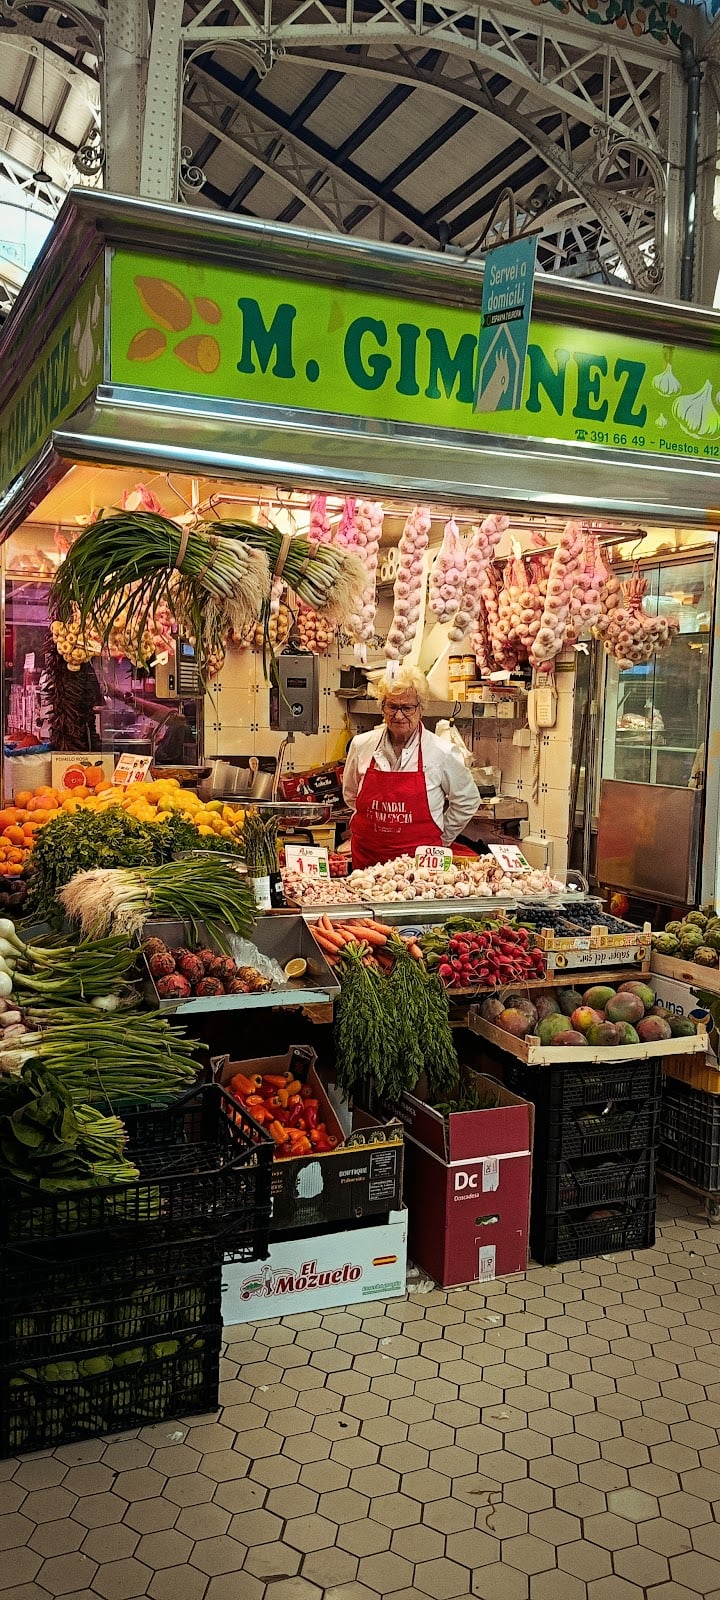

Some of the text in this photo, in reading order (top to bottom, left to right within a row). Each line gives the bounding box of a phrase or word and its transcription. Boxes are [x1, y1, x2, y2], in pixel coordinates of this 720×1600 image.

[490, 258, 518, 286] Servei
[488, 282, 525, 312] domicili
[236, 297, 648, 428] M. GIMNEZ
[590, 430, 609, 442] 391
[613, 433, 627, 445] 66
[631, 435, 646, 447] 49
[659, 438, 699, 454] Puestos
[703, 445, 720, 457] 412
[381, 801, 407, 813] NADAL
[454, 1171, 479, 1192] Dc
[453, 1192, 480, 1202] Doscadesa
[276, 1264, 361, 1295] Mozuelo
[301, 1260, 316, 1276] El
